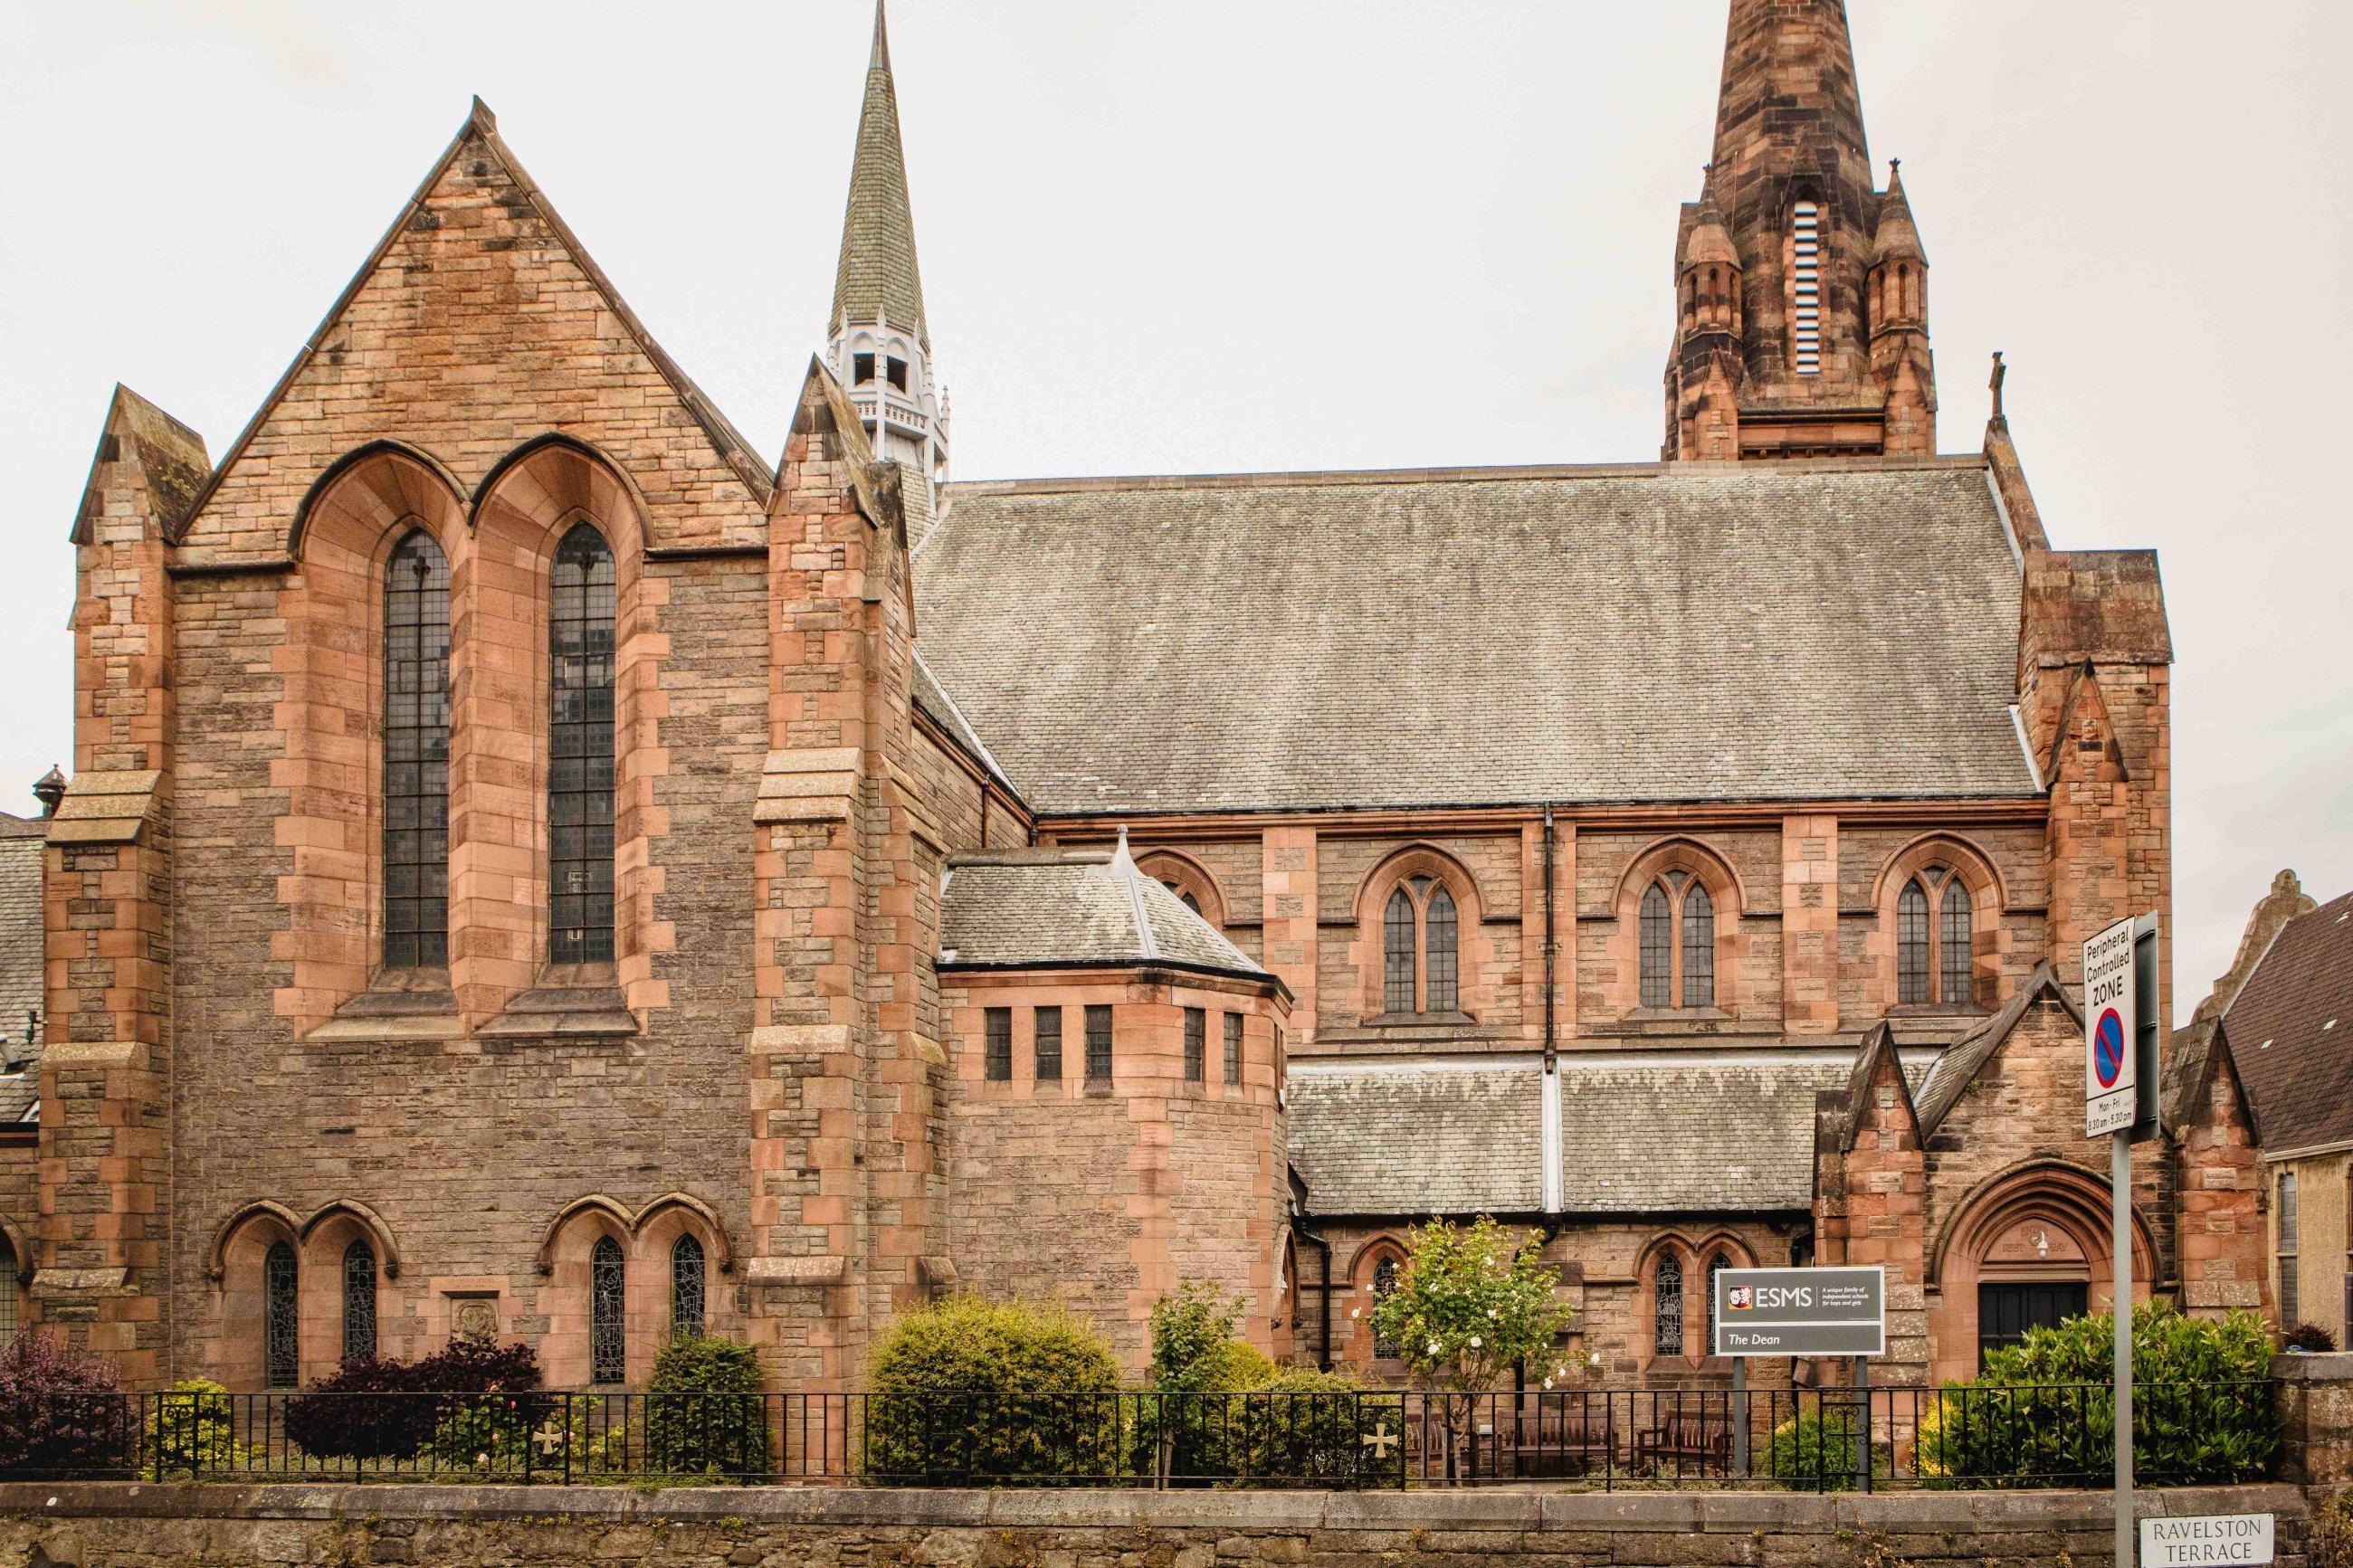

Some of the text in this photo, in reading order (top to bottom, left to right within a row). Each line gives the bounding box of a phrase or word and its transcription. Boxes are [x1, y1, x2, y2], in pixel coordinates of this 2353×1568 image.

[2087, 926, 2129, 962] Peripheral
[2087, 947, 2129, 983] Controlled
[2093, 975, 2123, 1007] ZONE
[2100, 1102, 2110, 1112] Mon
[2088, 1118, 2100, 1131] 8.30
[2100, 1119, 2108, 1127] am
[2110, 1112, 2123, 1125] 5.30
[2123, 1112, 2132, 1123] pm
[1756, 1287, 1813, 1307] ESMS
[1729, 1334, 1780, 1345] The Dean
[2154, 1519, 2261, 1540] RAVELSTON
[2165, 1542, 2252, 1562] TERRACE
